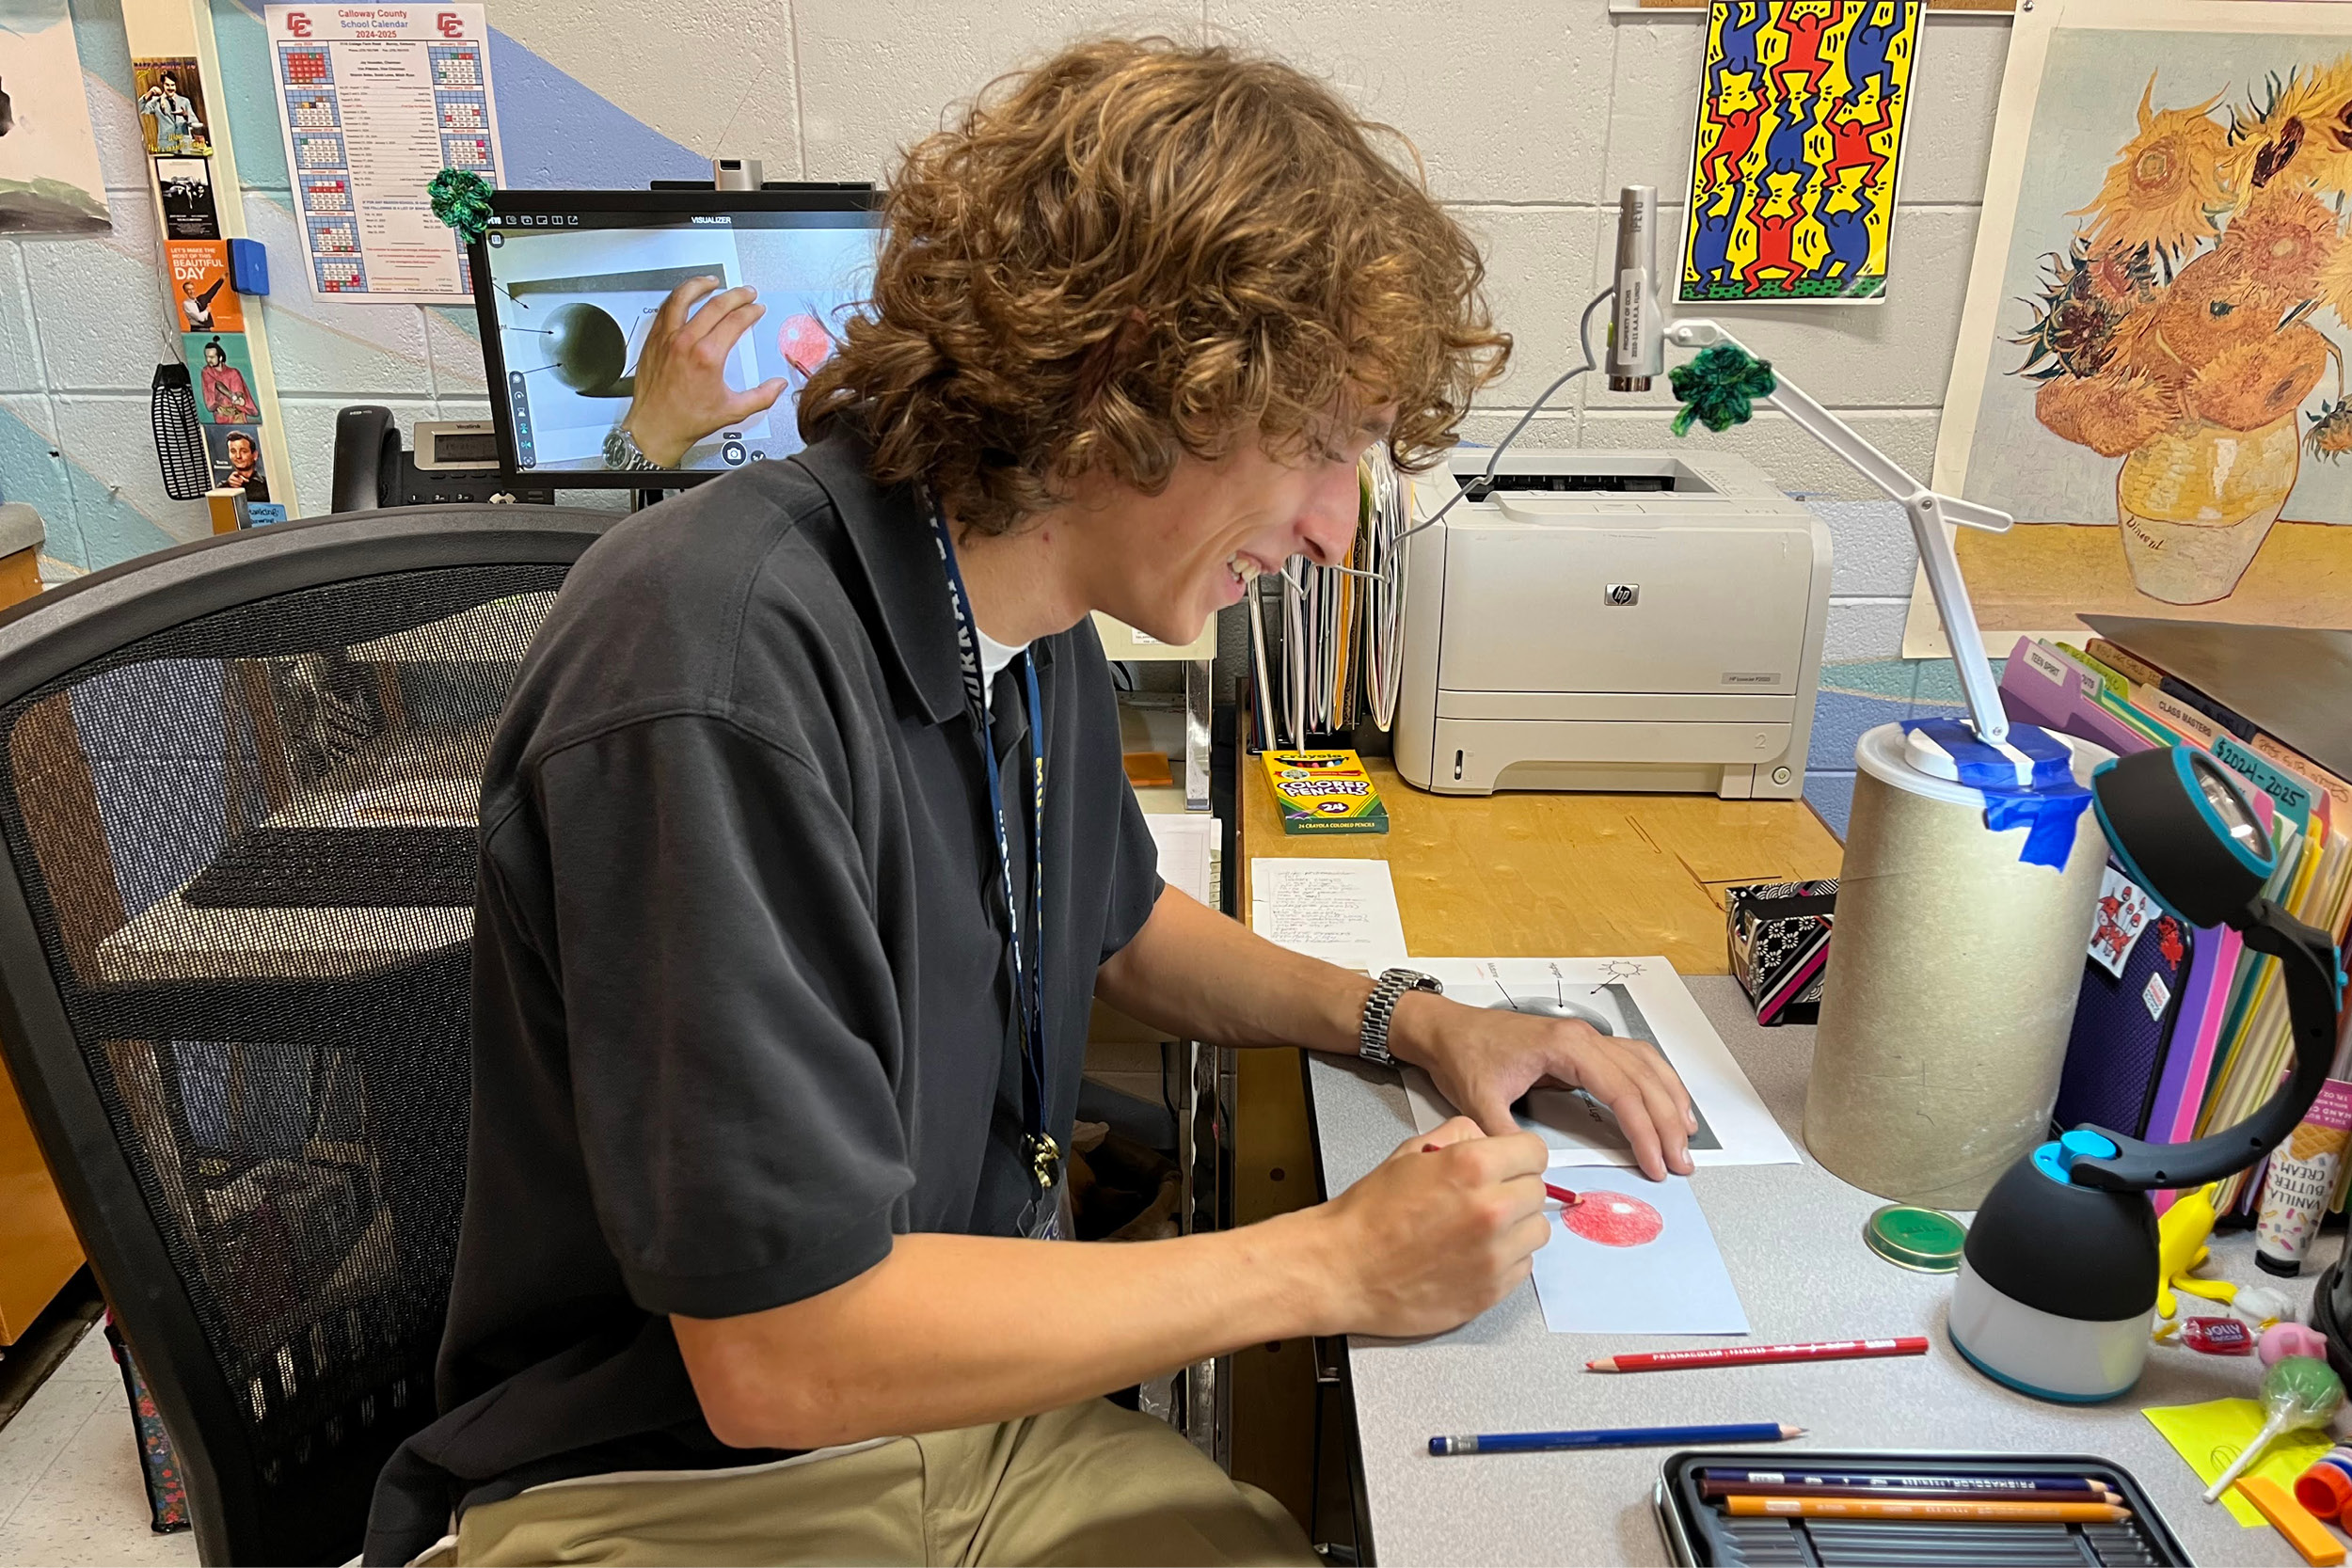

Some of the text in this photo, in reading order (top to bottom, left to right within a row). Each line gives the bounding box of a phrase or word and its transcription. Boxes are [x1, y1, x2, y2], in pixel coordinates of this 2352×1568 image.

[338, 9, 407, 19] Calloway County
[173, 259, 224, 268] BEAUTIFUL
[175, 267, 206, 280] DAY
[1624, 307, 1631, 317] OF
[2126, 515, 2166, 551] Vincent
[2031, 653, 2060, 676] TEEN SPIRIT
[2159, 701, 2211, 737] CLASS MASTERS
[1754, 733, 1767, 749] 2
[1278, 781, 1369, 790] COLORED
[1286, 787, 1369, 796] PENCILS
[1321, 802, 1346, 811] 24
[2280, 1162, 2325, 1181] CREAM
[2274, 1173, 2325, 1196] BUTTER
[2270, 1188, 2320, 1210] VANILLA
[2204, 1323, 2241, 1336] JOLLY
[1653, 1350, 1723, 1361] PRISMACOLOR
[1955, 1480, 2035, 1489] PRISMACOLOR
